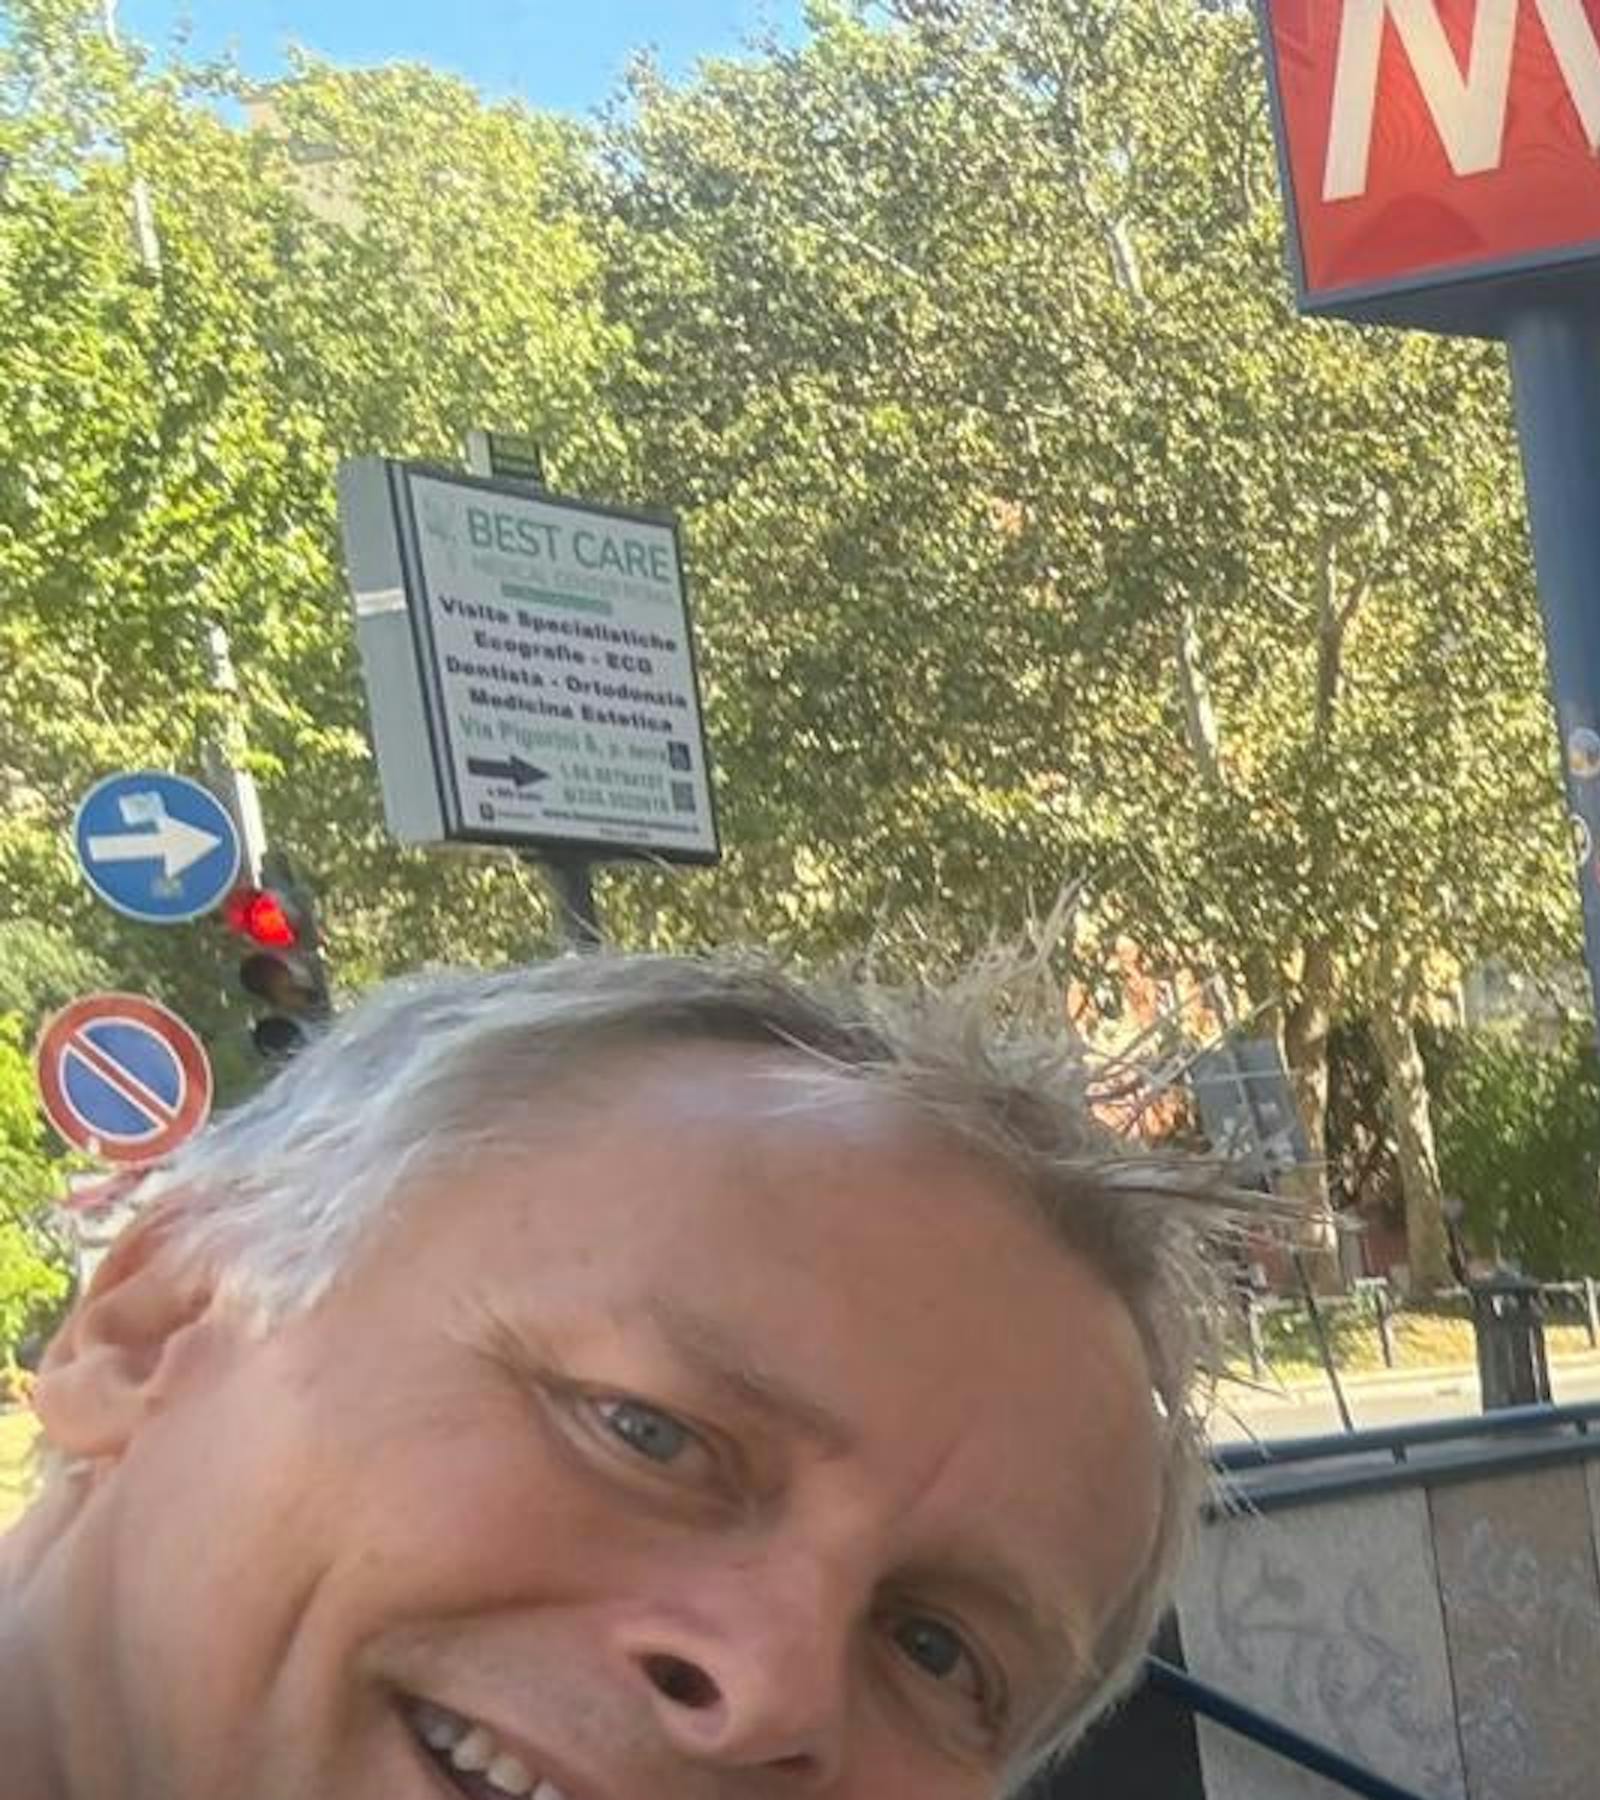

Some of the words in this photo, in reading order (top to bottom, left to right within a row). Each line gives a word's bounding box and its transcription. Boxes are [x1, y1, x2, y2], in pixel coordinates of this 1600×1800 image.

[467, 507, 561, 561] BEST
[572, 530, 672, 584] CARE
[438, 594, 510, 624] Visite
[517, 611, 677, 653] Specialistiche
[474, 631, 586, 664] Ecografie
[446, 656, 544, 687] Dentista
[565, 675, 688, 709] Ortodonzia
[469, 688, 574, 719] Medicina
[581, 705, 673, 733] Estetica
